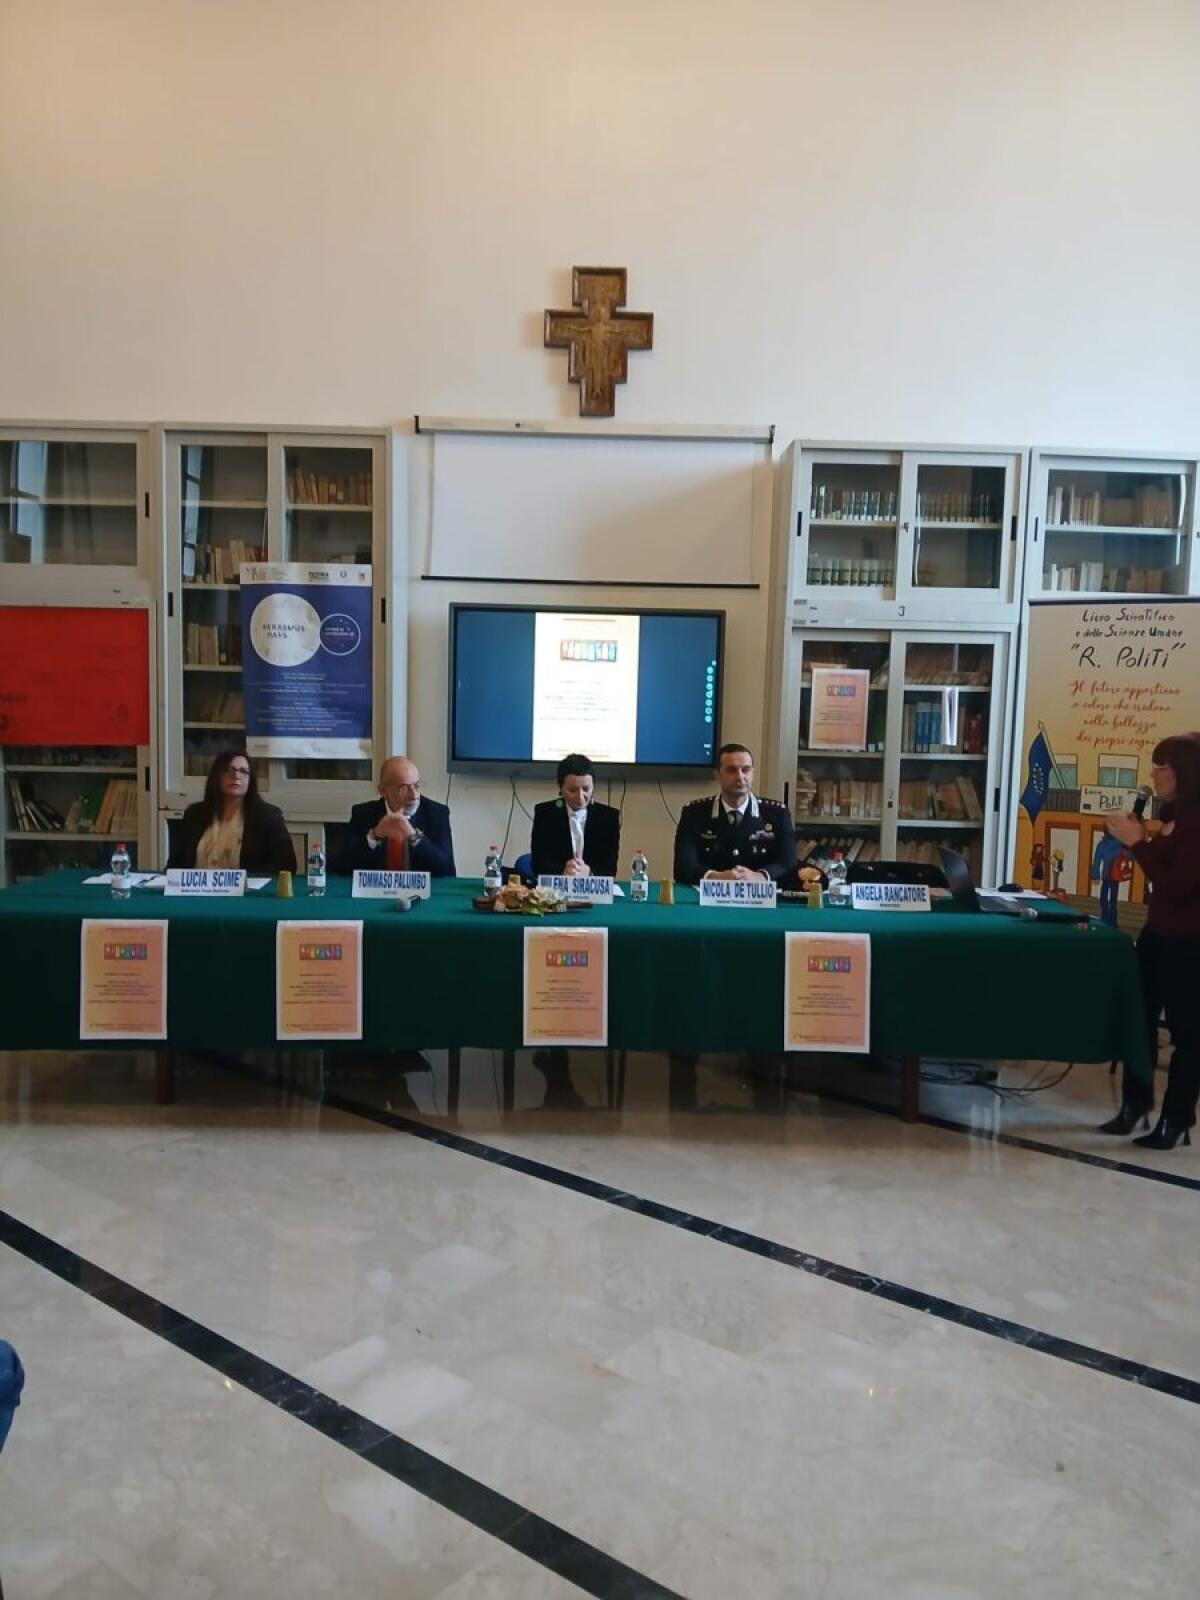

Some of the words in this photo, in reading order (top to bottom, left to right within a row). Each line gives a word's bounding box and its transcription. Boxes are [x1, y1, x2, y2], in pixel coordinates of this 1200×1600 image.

[1082, 609, 1110, 622] Liceo
[267, 632, 288, 640] DAYS
[1083, 628, 1103, 638] delle
[1104, 624, 1145, 638] Scienze
[1149, 627, 1184, 638] Umane
[1068, 680, 1085, 697] Il
[1091, 680, 1121, 695] futuro
[1123, 682, 1181, 700] appartiene
[1082, 699, 1111, 711] coloro
[1113, 699, 1129, 710] che
[1132, 699, 1171, 713] credono
[1083, 714, 1109, 726] nella
[1112, 714, 1157, 734] bellezza
[1094, 736, 1125, 750] propri
[181, 871, 207, 887] LUCIA
[358, 871, 393, 889] TOMMASO
[394, 873, 426, 889] PALUMBO
[572, 878, 610, 895] SIRACUSA
[703, 881, 730, 897] NICOLA
[734, 882, 745, 898] DE
[746, 882, 773, 898] TULLIO
[855, 884, 883, 901] ANGELA
[884, 886, 926, 903] RANCATORE
